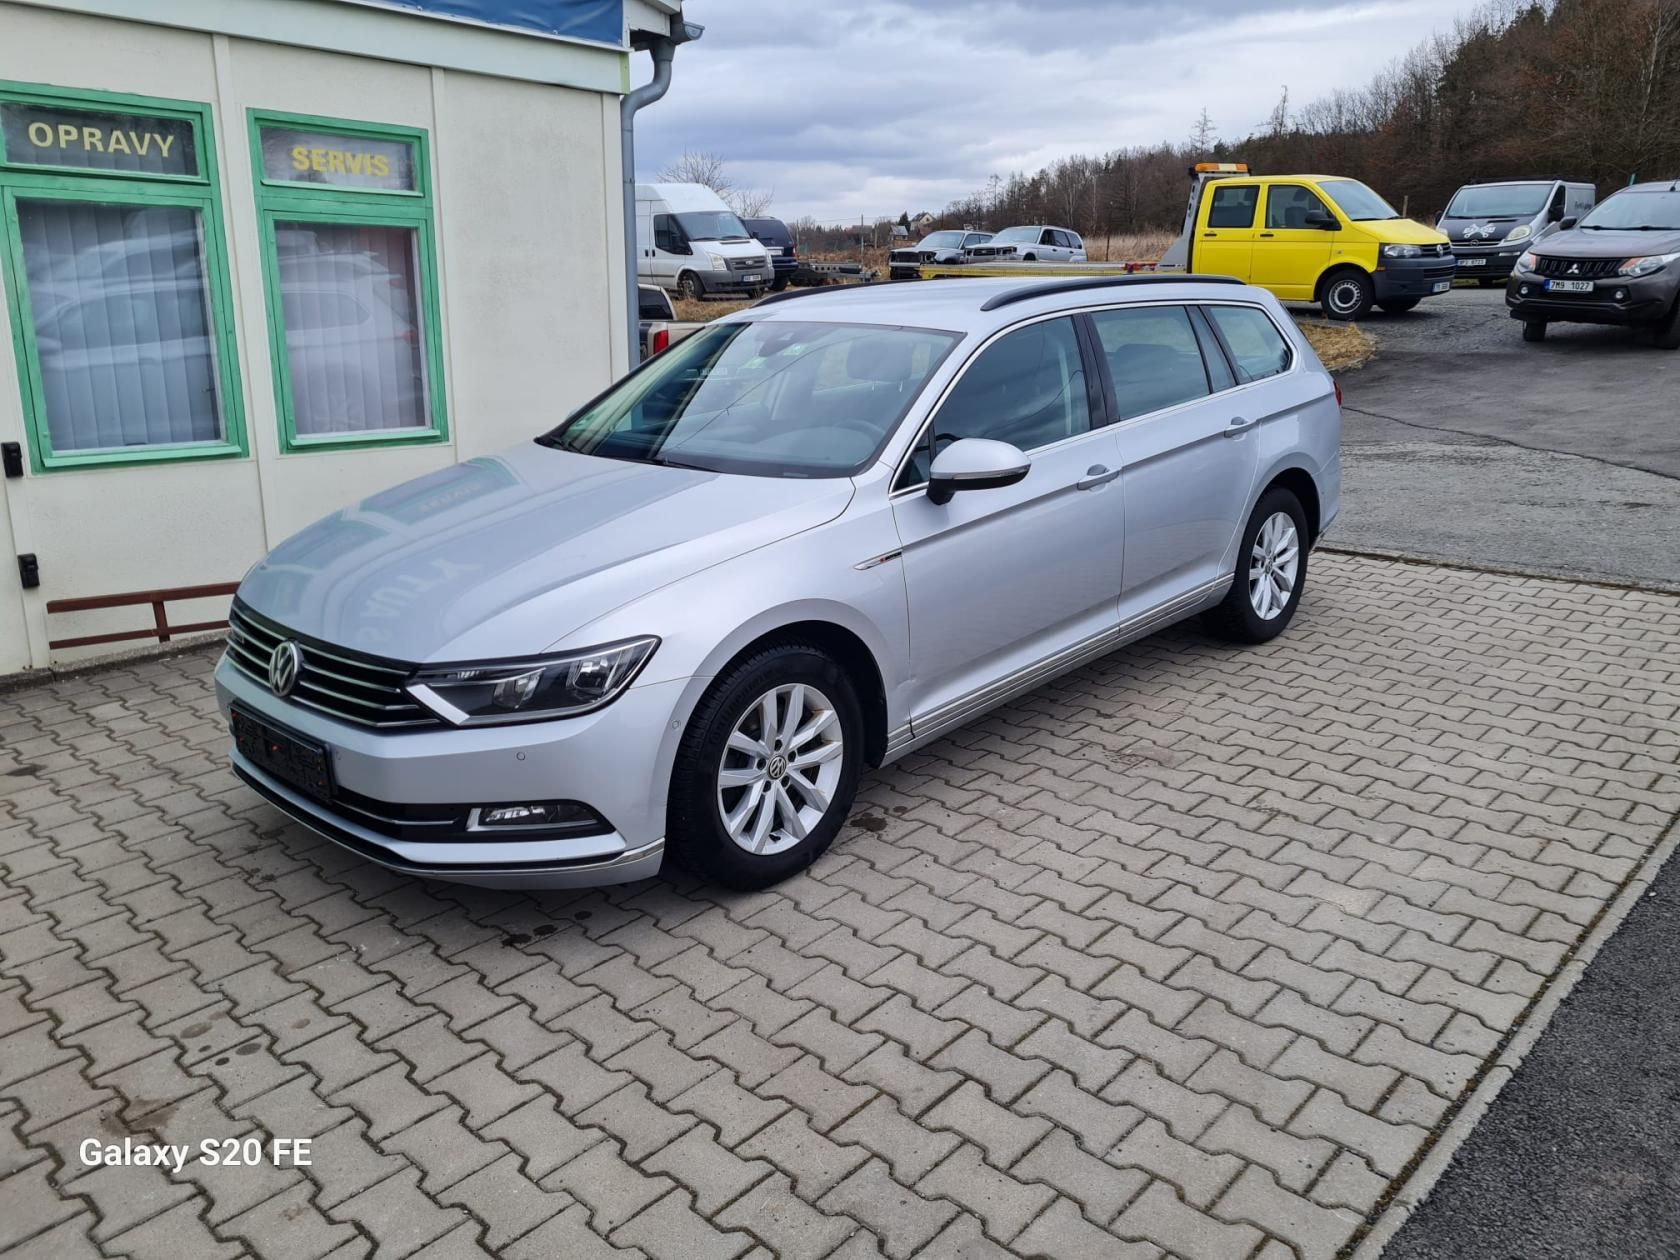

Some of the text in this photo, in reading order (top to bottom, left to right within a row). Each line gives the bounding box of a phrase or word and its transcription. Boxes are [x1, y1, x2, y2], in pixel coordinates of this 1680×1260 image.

[28, 121, 175, 158] OPRAVY
[291, 145, 389, 177] SERVIS
[1571, 281, 1590, 290] 1027
